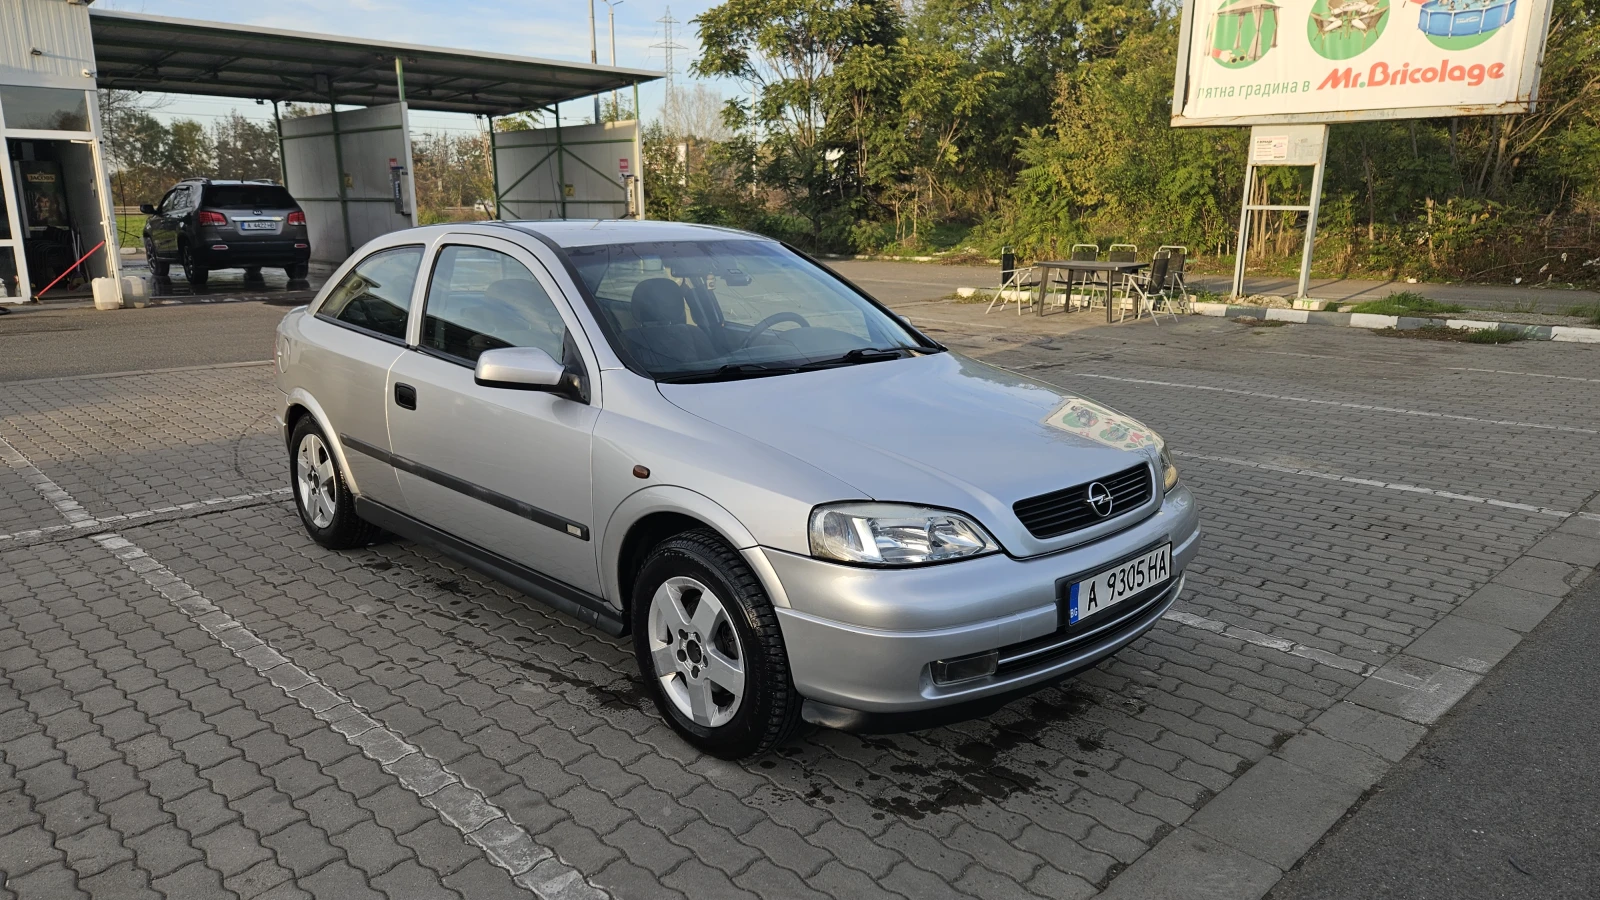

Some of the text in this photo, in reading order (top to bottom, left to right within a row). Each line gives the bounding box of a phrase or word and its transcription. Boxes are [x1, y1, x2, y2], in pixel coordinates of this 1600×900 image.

[1238, 81, 1298, 100] градина
[1302, 80, 1311, 93] в
[1316, 59, 1505, 92] Mr.Bricolage
[1087, 580, 1098, 612] A
